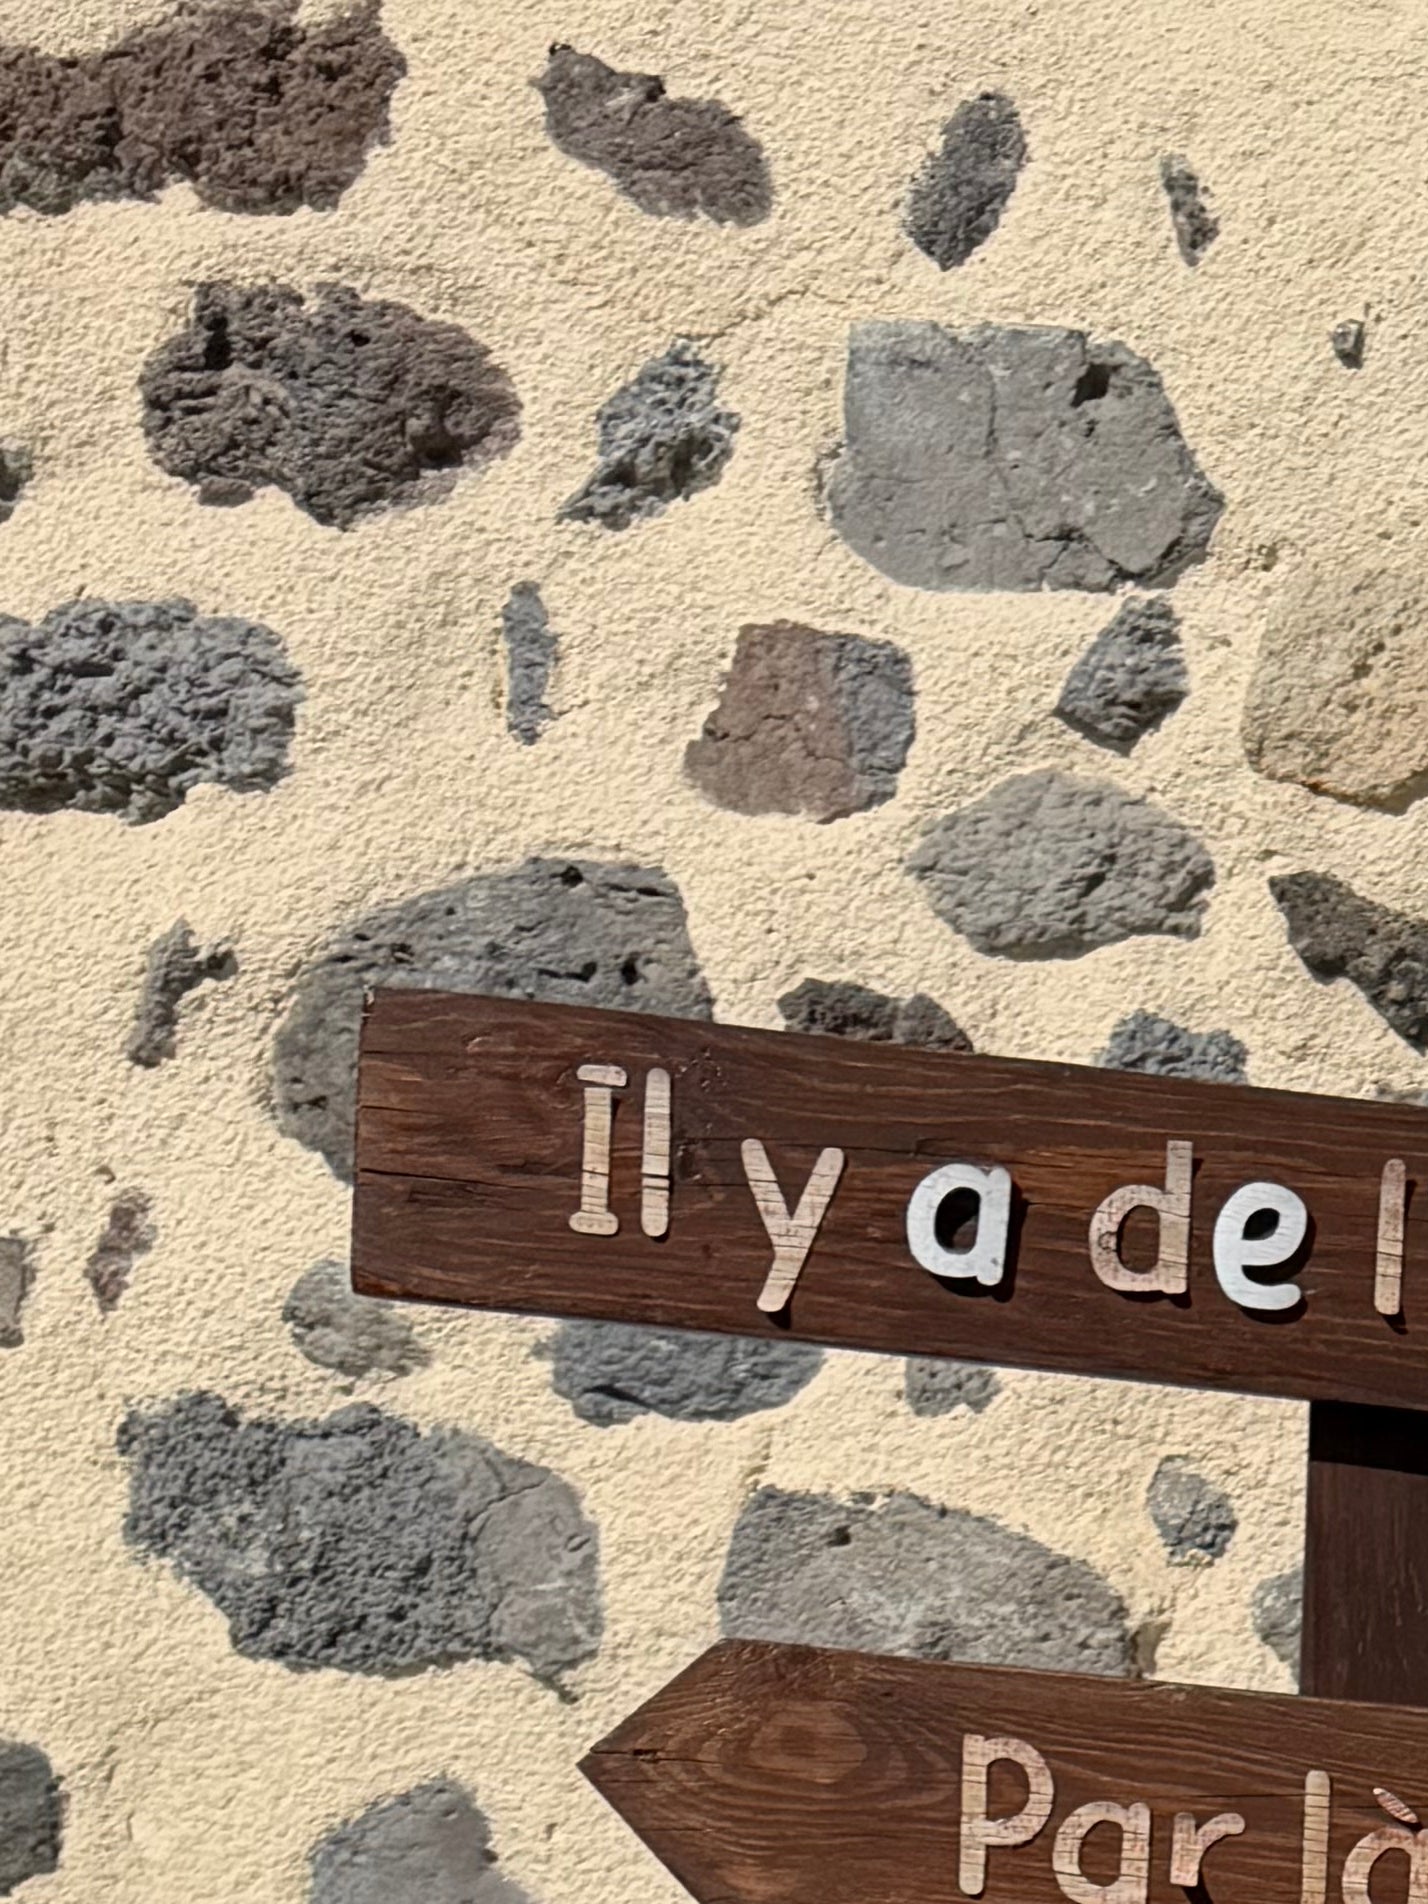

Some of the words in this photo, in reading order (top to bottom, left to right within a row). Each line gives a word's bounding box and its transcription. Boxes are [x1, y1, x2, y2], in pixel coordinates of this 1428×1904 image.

[569, 1065, 673, 1239] Il
[740, 1137, 844, 1313] y
[907, 1162, 1014, 1288] a
[1088, 1140, 1310, 1312] de
